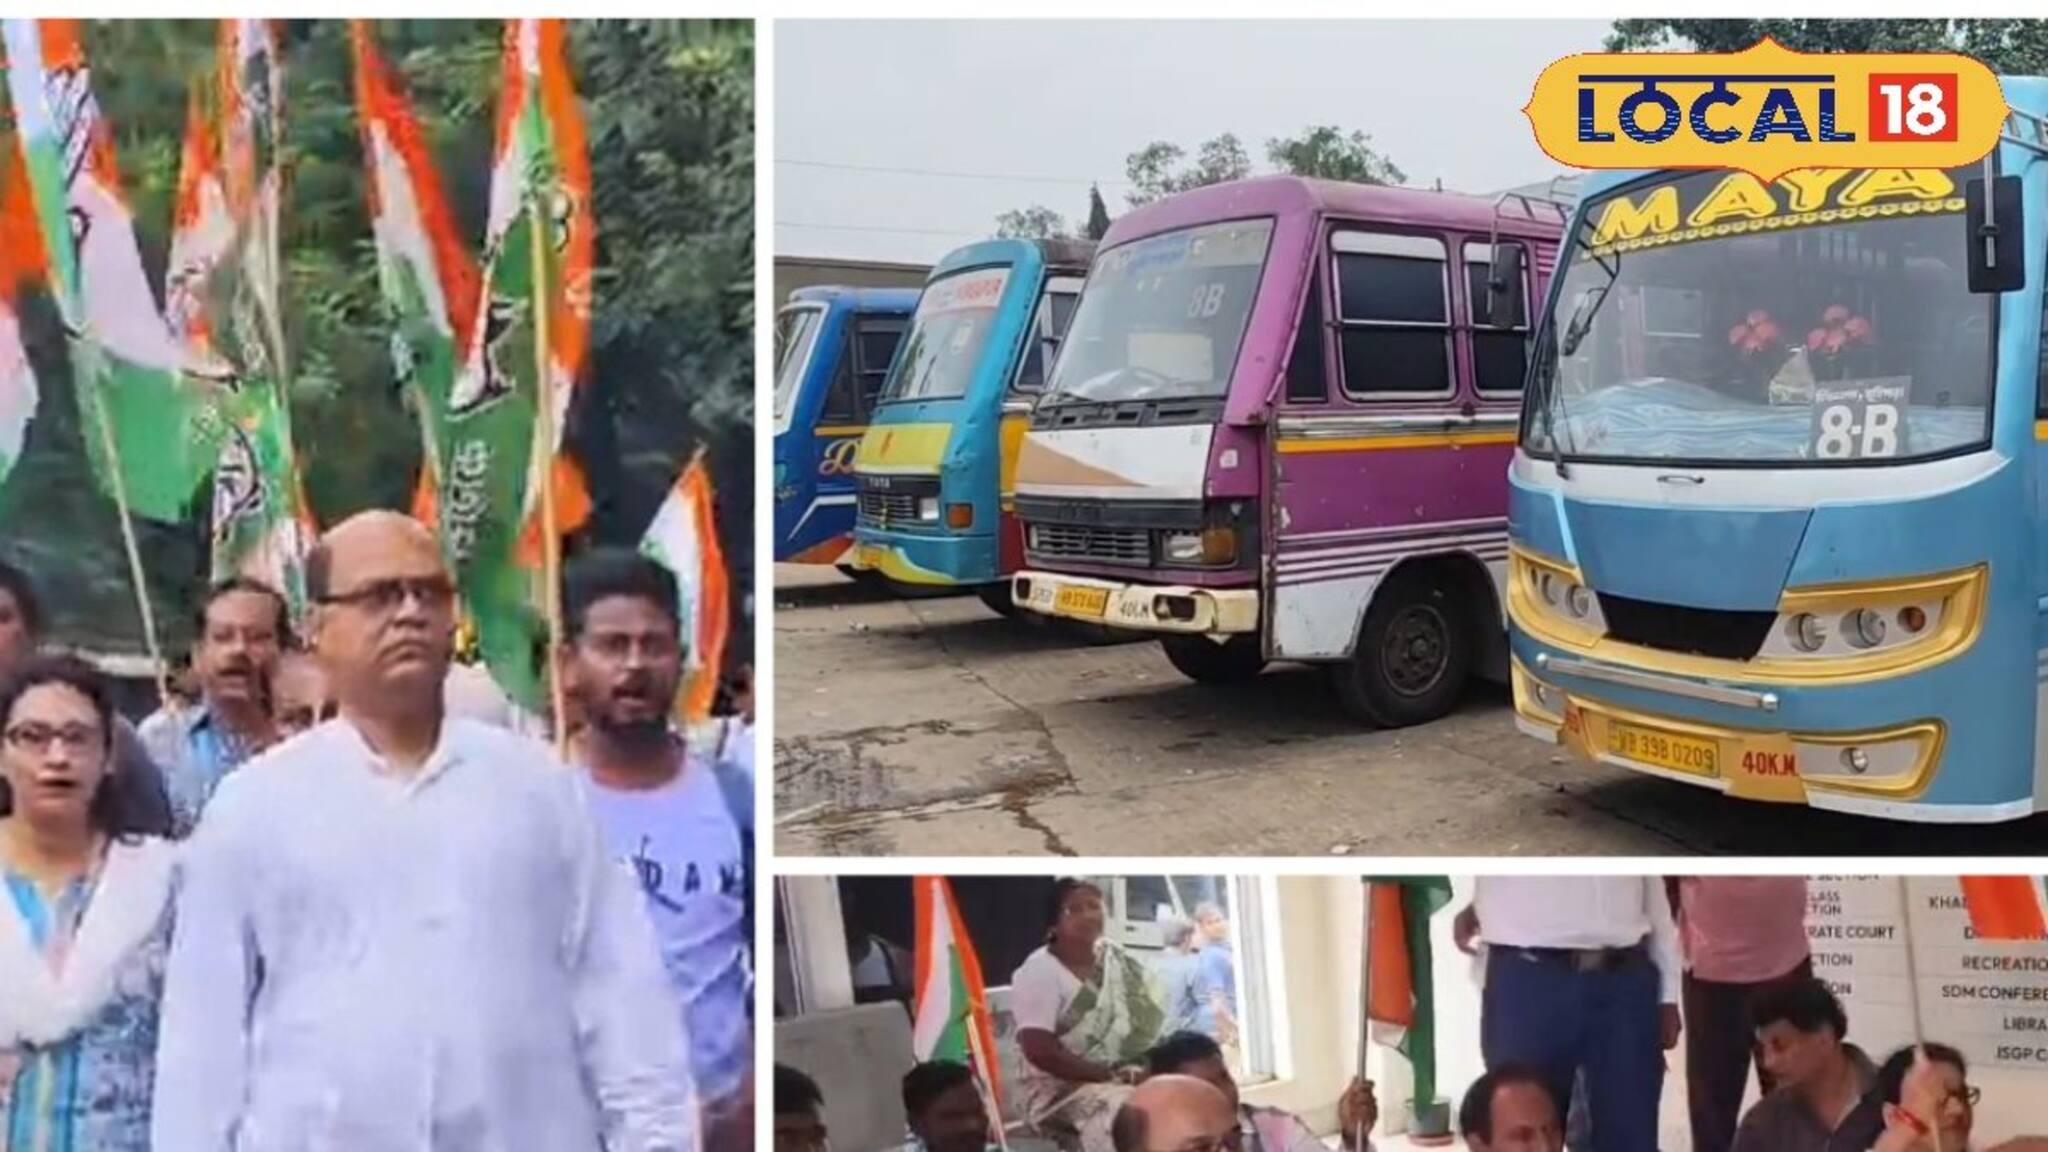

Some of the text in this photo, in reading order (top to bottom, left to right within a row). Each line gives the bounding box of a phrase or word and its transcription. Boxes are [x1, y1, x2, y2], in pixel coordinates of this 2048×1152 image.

[1591, 168, 1956, 247] MAYA
[1816, 403, 1898, 459] 8-B
[1672, 741, 1715, 772] 0209
[1846, 926, 1895, 940] COURT
[1942, 985, 1975, 998] SDM
[1997, 1046, 2032, 1061] ISGP
